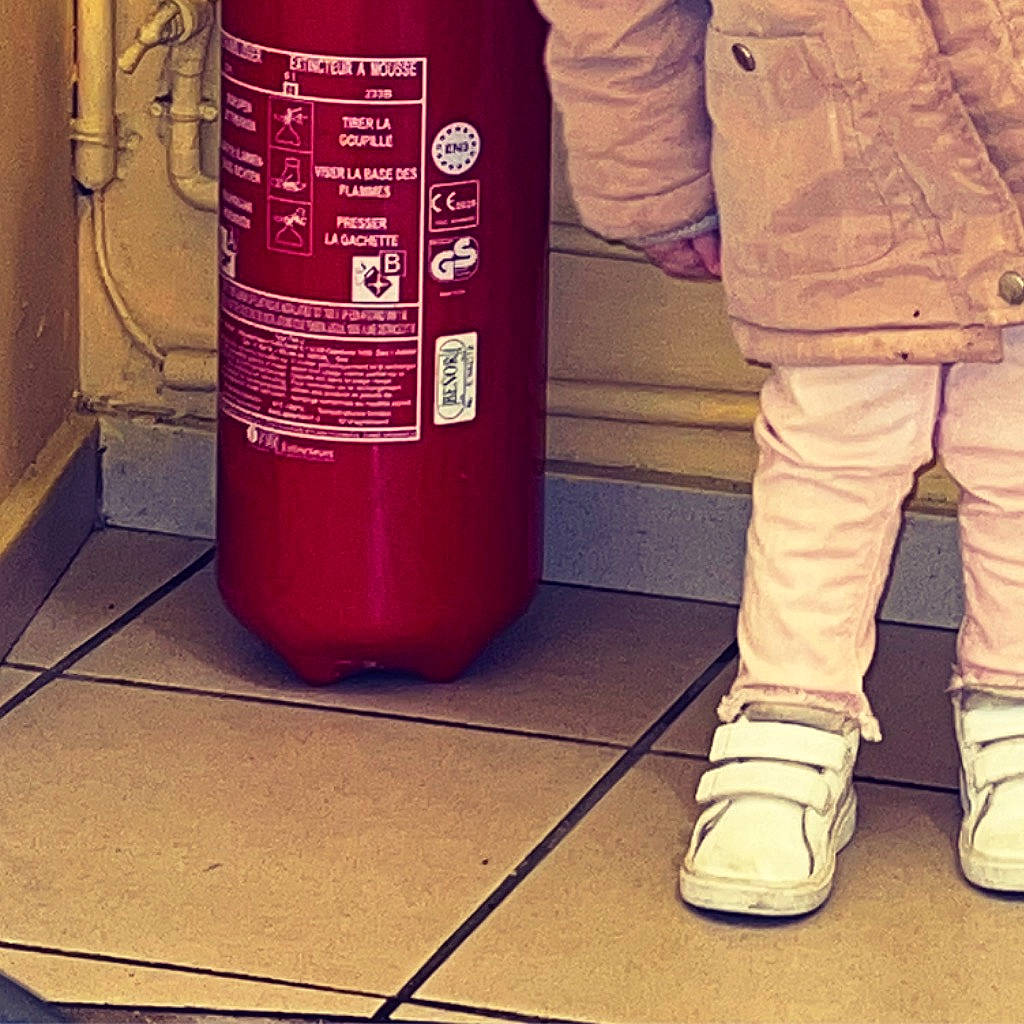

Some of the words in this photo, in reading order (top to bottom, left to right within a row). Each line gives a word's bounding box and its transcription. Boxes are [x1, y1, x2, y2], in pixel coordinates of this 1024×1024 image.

[356, 61, 366, 77] A
[370, 61, 417, 77] MOUSSE
[341, 116, 374, 130] TIRER
[375, 118, 392, 130] LA
[338, 134, 393, 148] GOUPILLE
[314, 165, 346, 180] VISER
[346, 167, 362, 180] LA
[363, 167, 393, 181] BASE
[395, 167, 418, 181] DES
[338, 183, 391, 198] FLAMMES
[431, 191, 456, 213] CE
[336, 216, 388, 230] PRESSER
[324, 232, 339, 246] LA
[340, 233, 399, 247] GACHETTE
[384, 253, 401, 274] B
